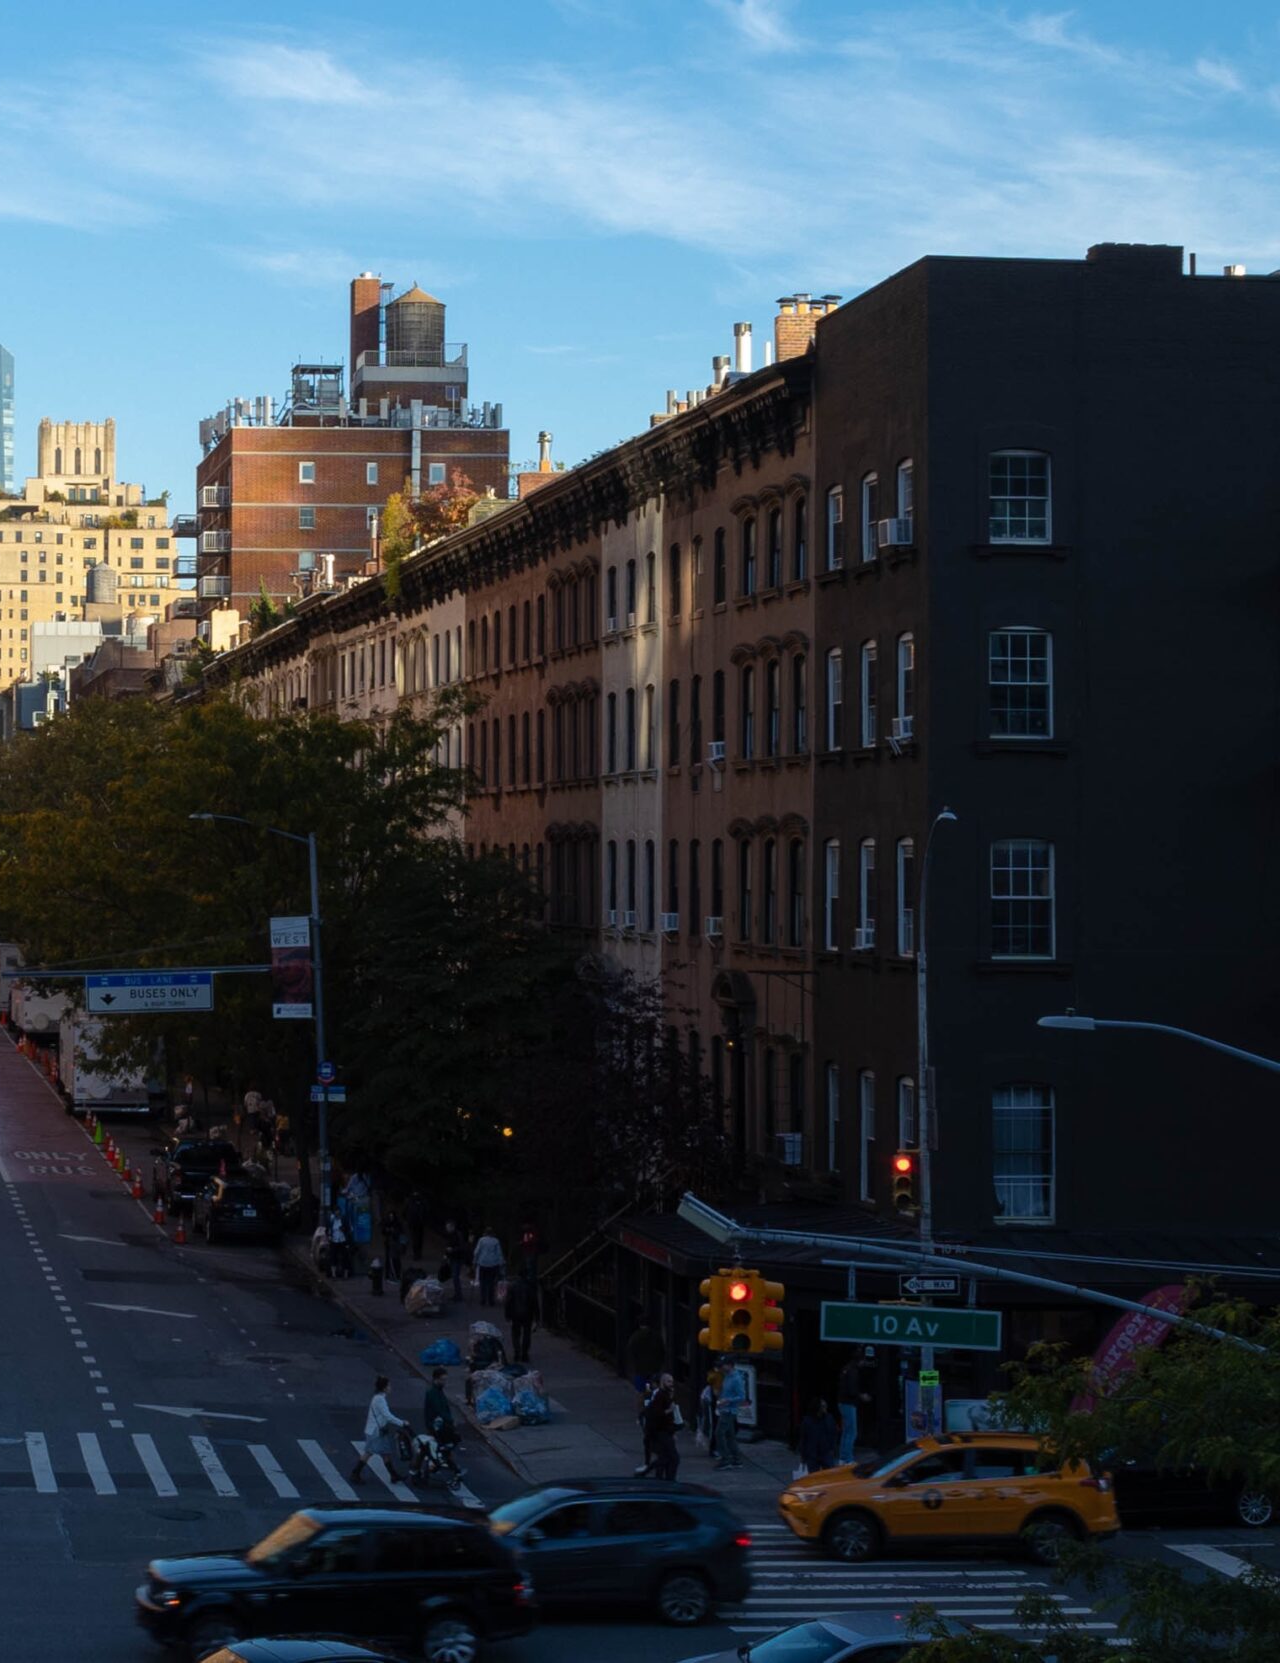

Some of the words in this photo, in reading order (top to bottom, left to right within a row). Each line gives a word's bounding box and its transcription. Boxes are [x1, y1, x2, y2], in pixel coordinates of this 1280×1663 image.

[272, 935, 307, 944] WEST
[124, 976, 141, 985] BUS
[150, 975, 174, 985] LANE
[129, 988, 166, 999] BUSES
[170, 987, 199, 998] ONLY
[14, 1151, 88, 1161] ONLY
[28, 1165, 97, 1176] BUS
[909, 1280, 924, 1289] ONE
[872, 1314, 898, 1334] 10
[905, 1316, 939, 1337] Av
